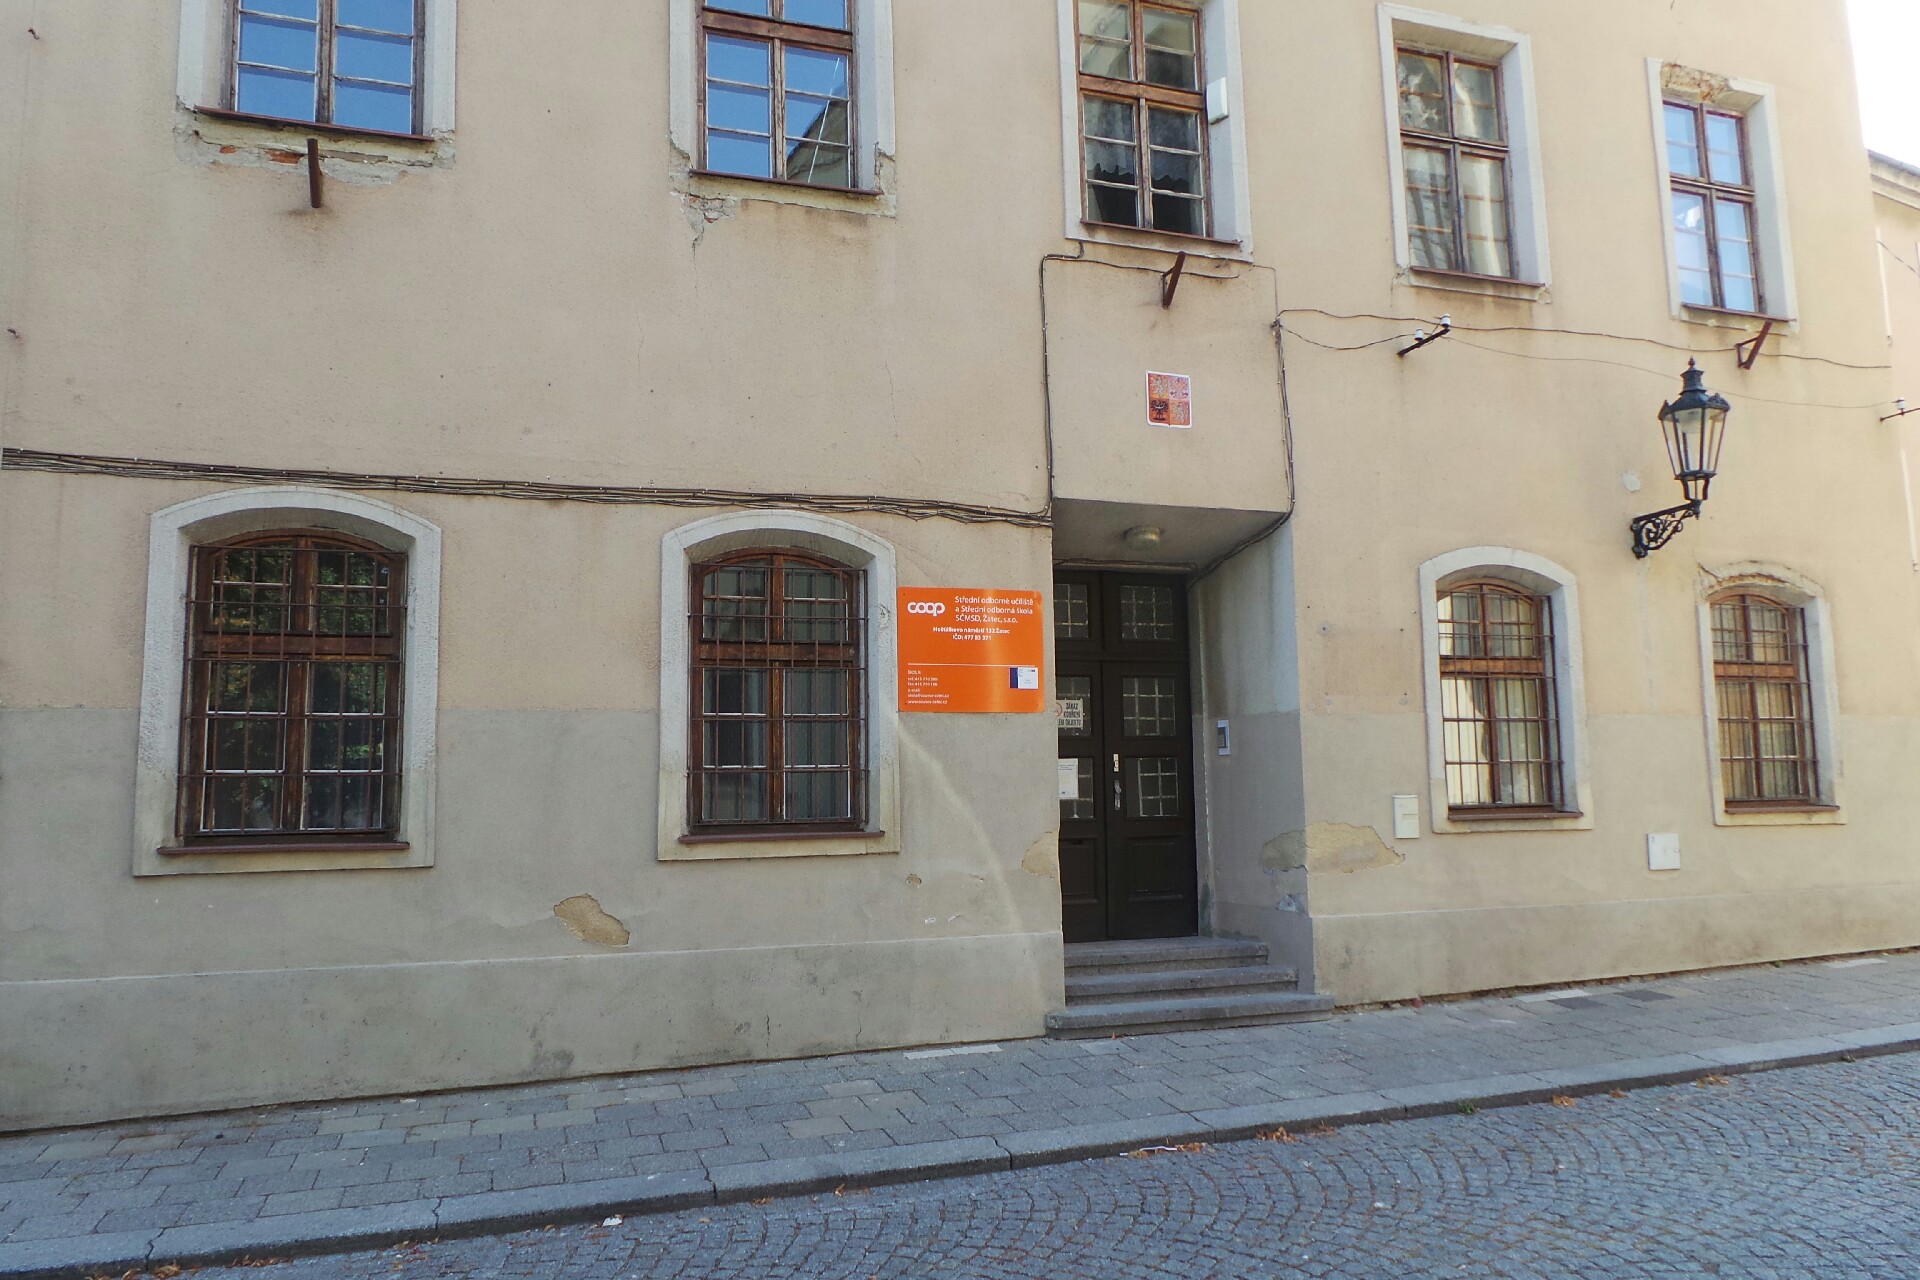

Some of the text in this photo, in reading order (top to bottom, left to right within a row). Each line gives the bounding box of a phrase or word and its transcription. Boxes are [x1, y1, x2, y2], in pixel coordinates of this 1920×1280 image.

[955, 596, 1034, 606] Střední odborné učiliště
[907, 601, 946, 617] coop
[961, 605, 986, 613] Střední
[986, 606, 1015, 614] odborná
[1016, 607, 1033, 615] škola
[955, 614, 982, 623] SČMSD,
[983, 614, 1003, 624] Žatec,
